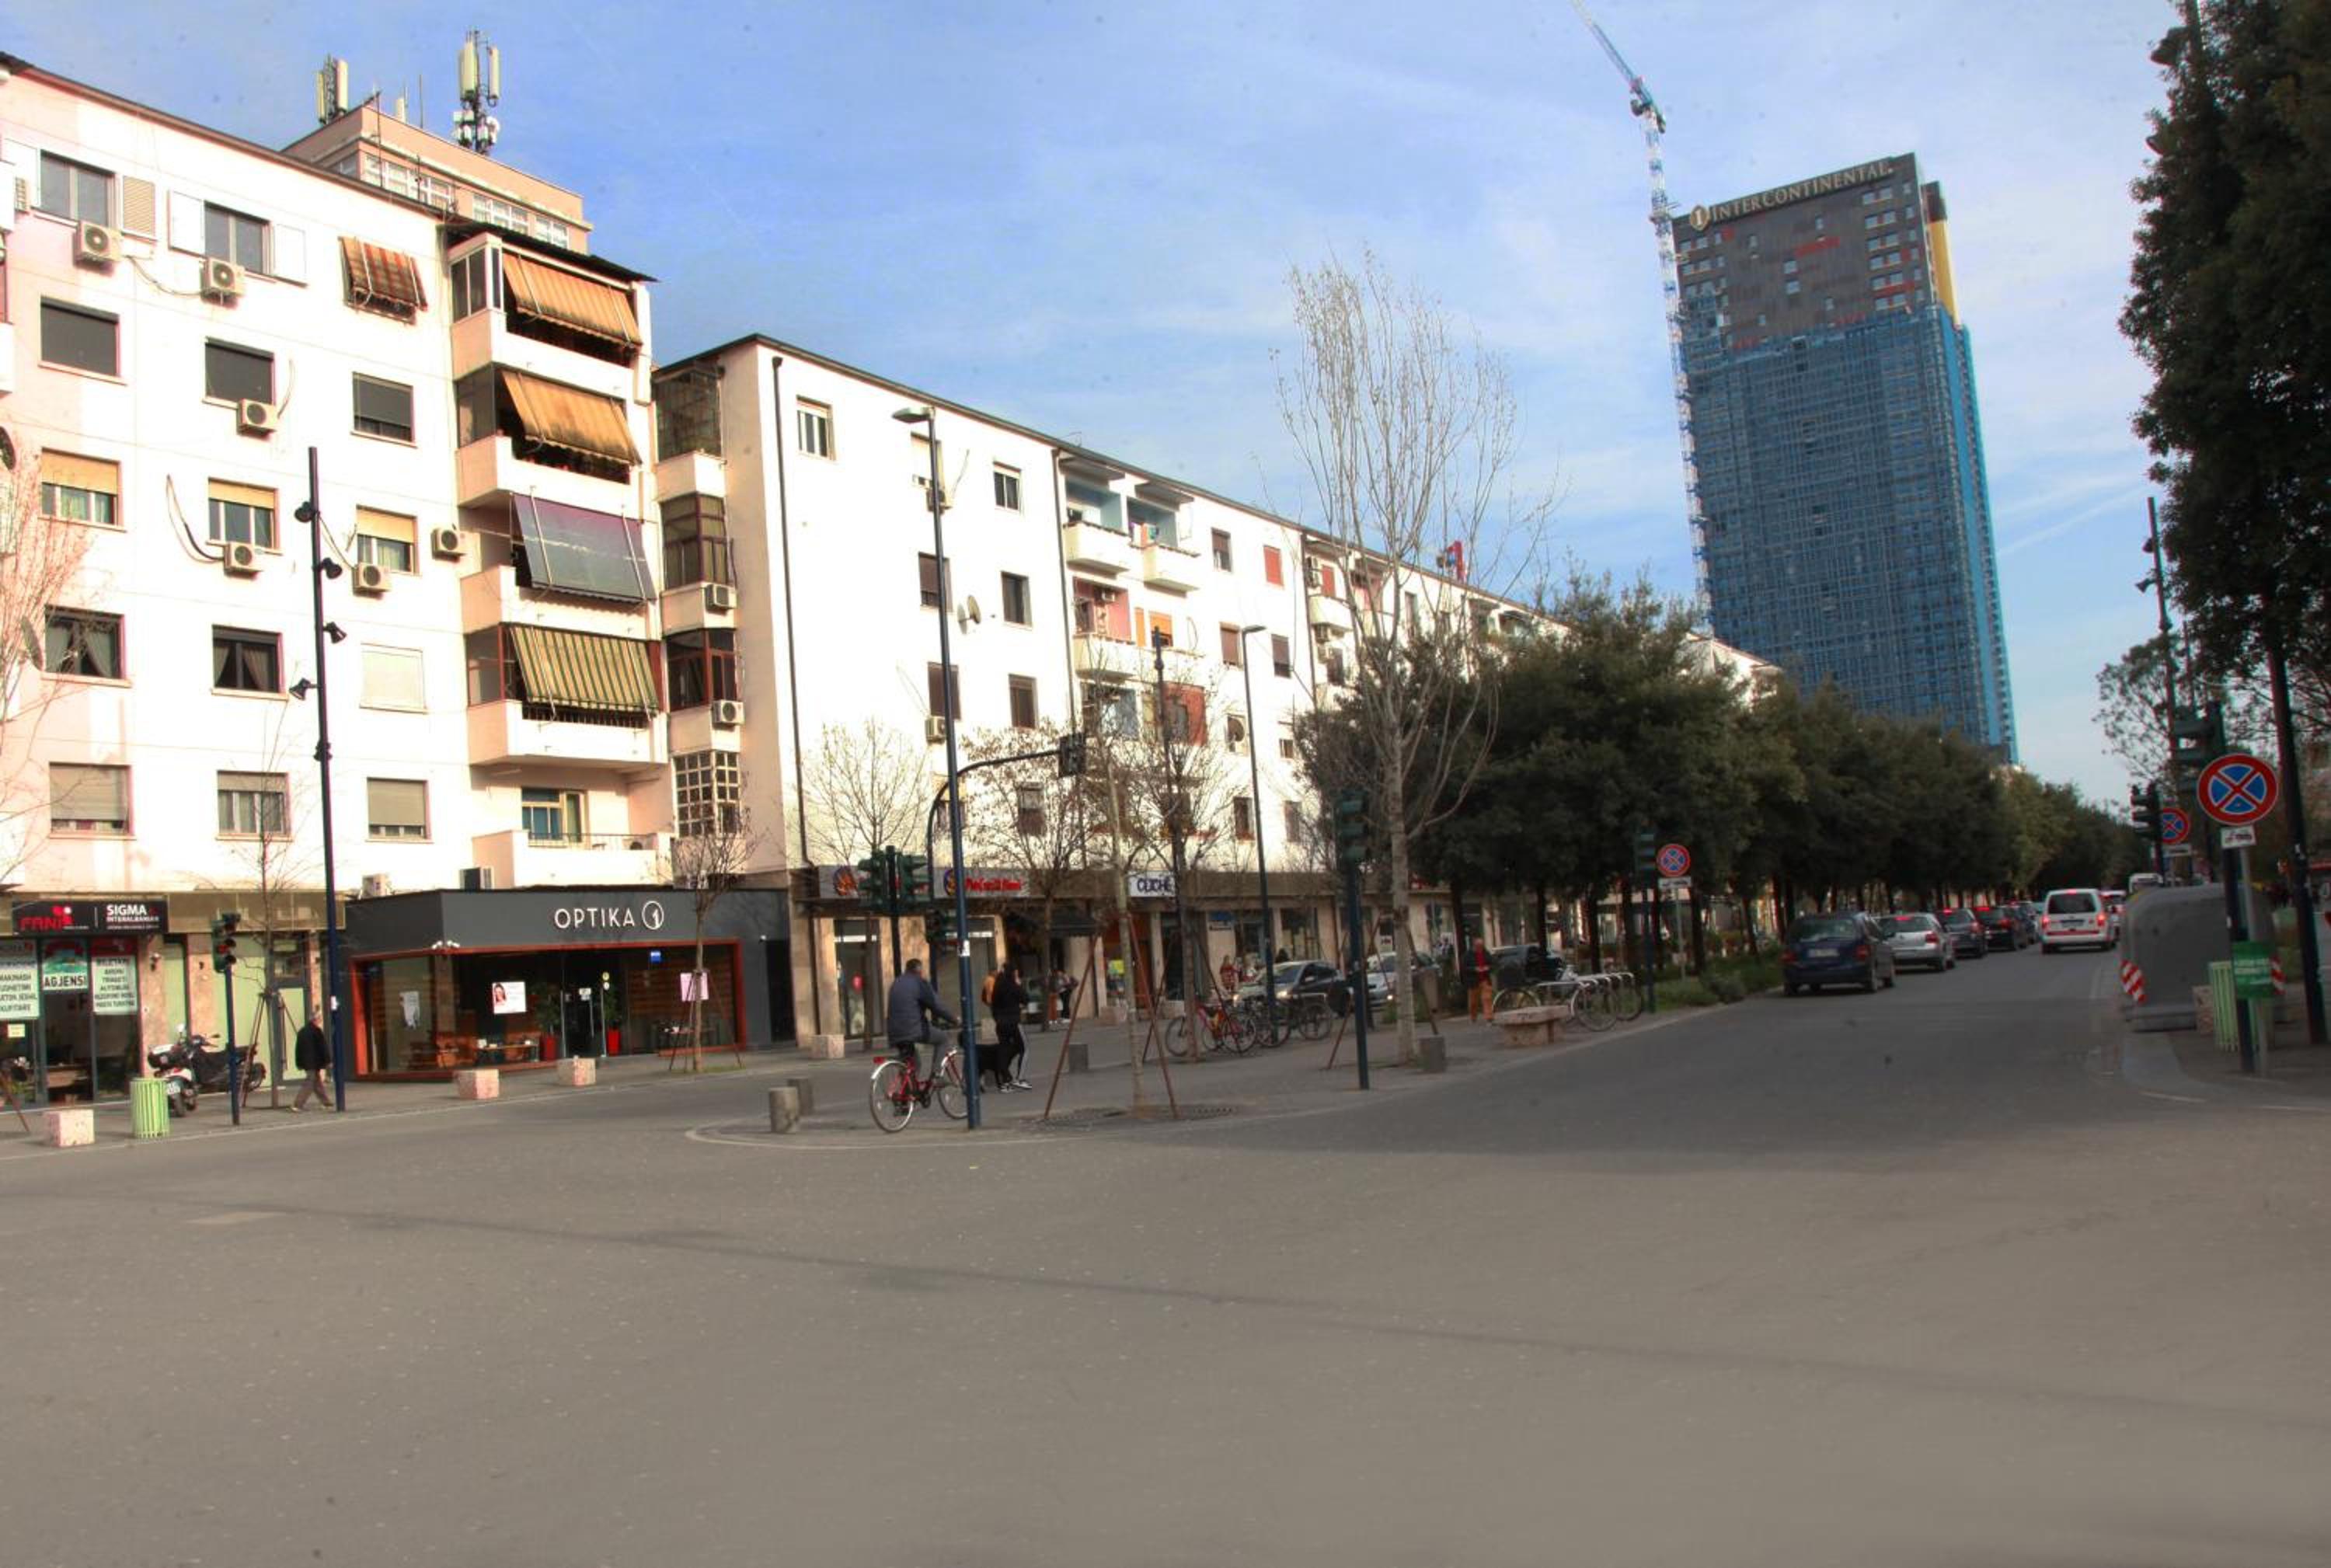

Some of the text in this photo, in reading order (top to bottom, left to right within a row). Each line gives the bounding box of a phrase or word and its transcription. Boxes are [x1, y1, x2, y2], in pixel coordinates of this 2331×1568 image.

[1712, 161, 1891, 222] INTERCONTINENTAL
[106, 904, 148, 916] SIGMA
[554, 908, 636, 929] OPTIKA
